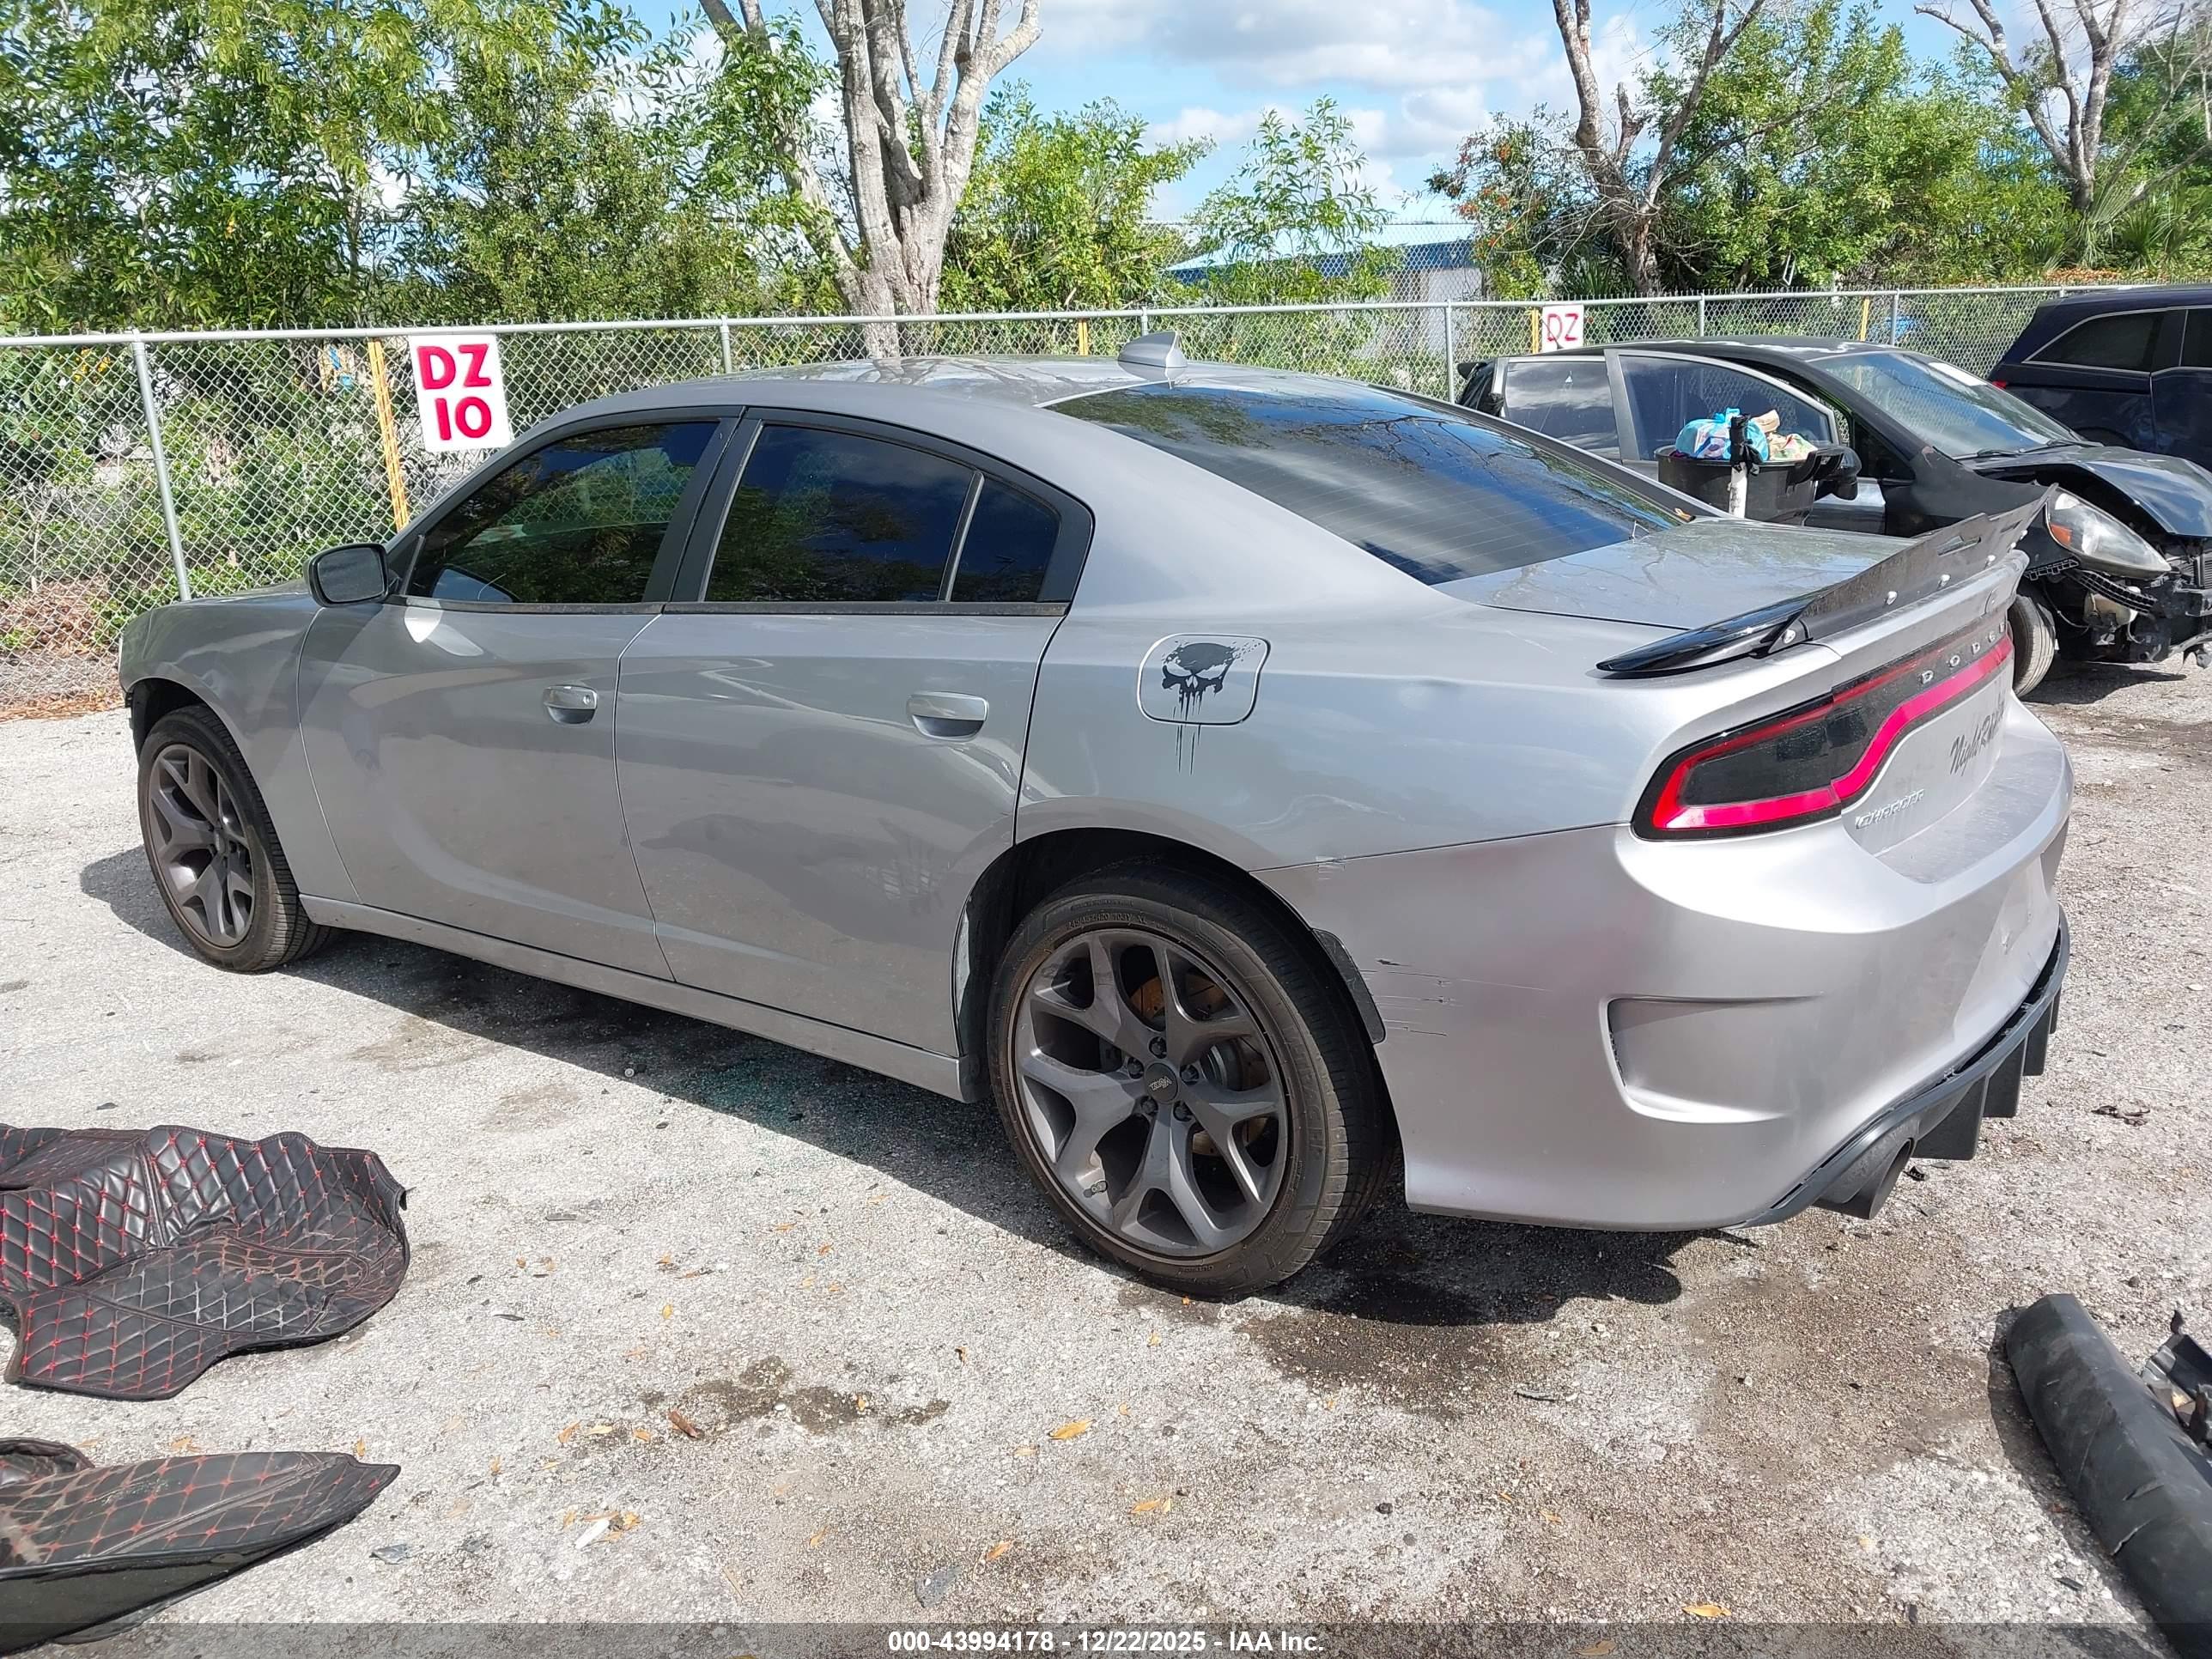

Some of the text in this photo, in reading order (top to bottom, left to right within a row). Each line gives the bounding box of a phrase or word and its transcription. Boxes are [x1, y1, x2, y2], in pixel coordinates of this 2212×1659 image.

[1547, 313, 1579, 342] DZ
[417, 343, 492, 390] DZ
[1855, 788, 1924, 830] CHARGER
